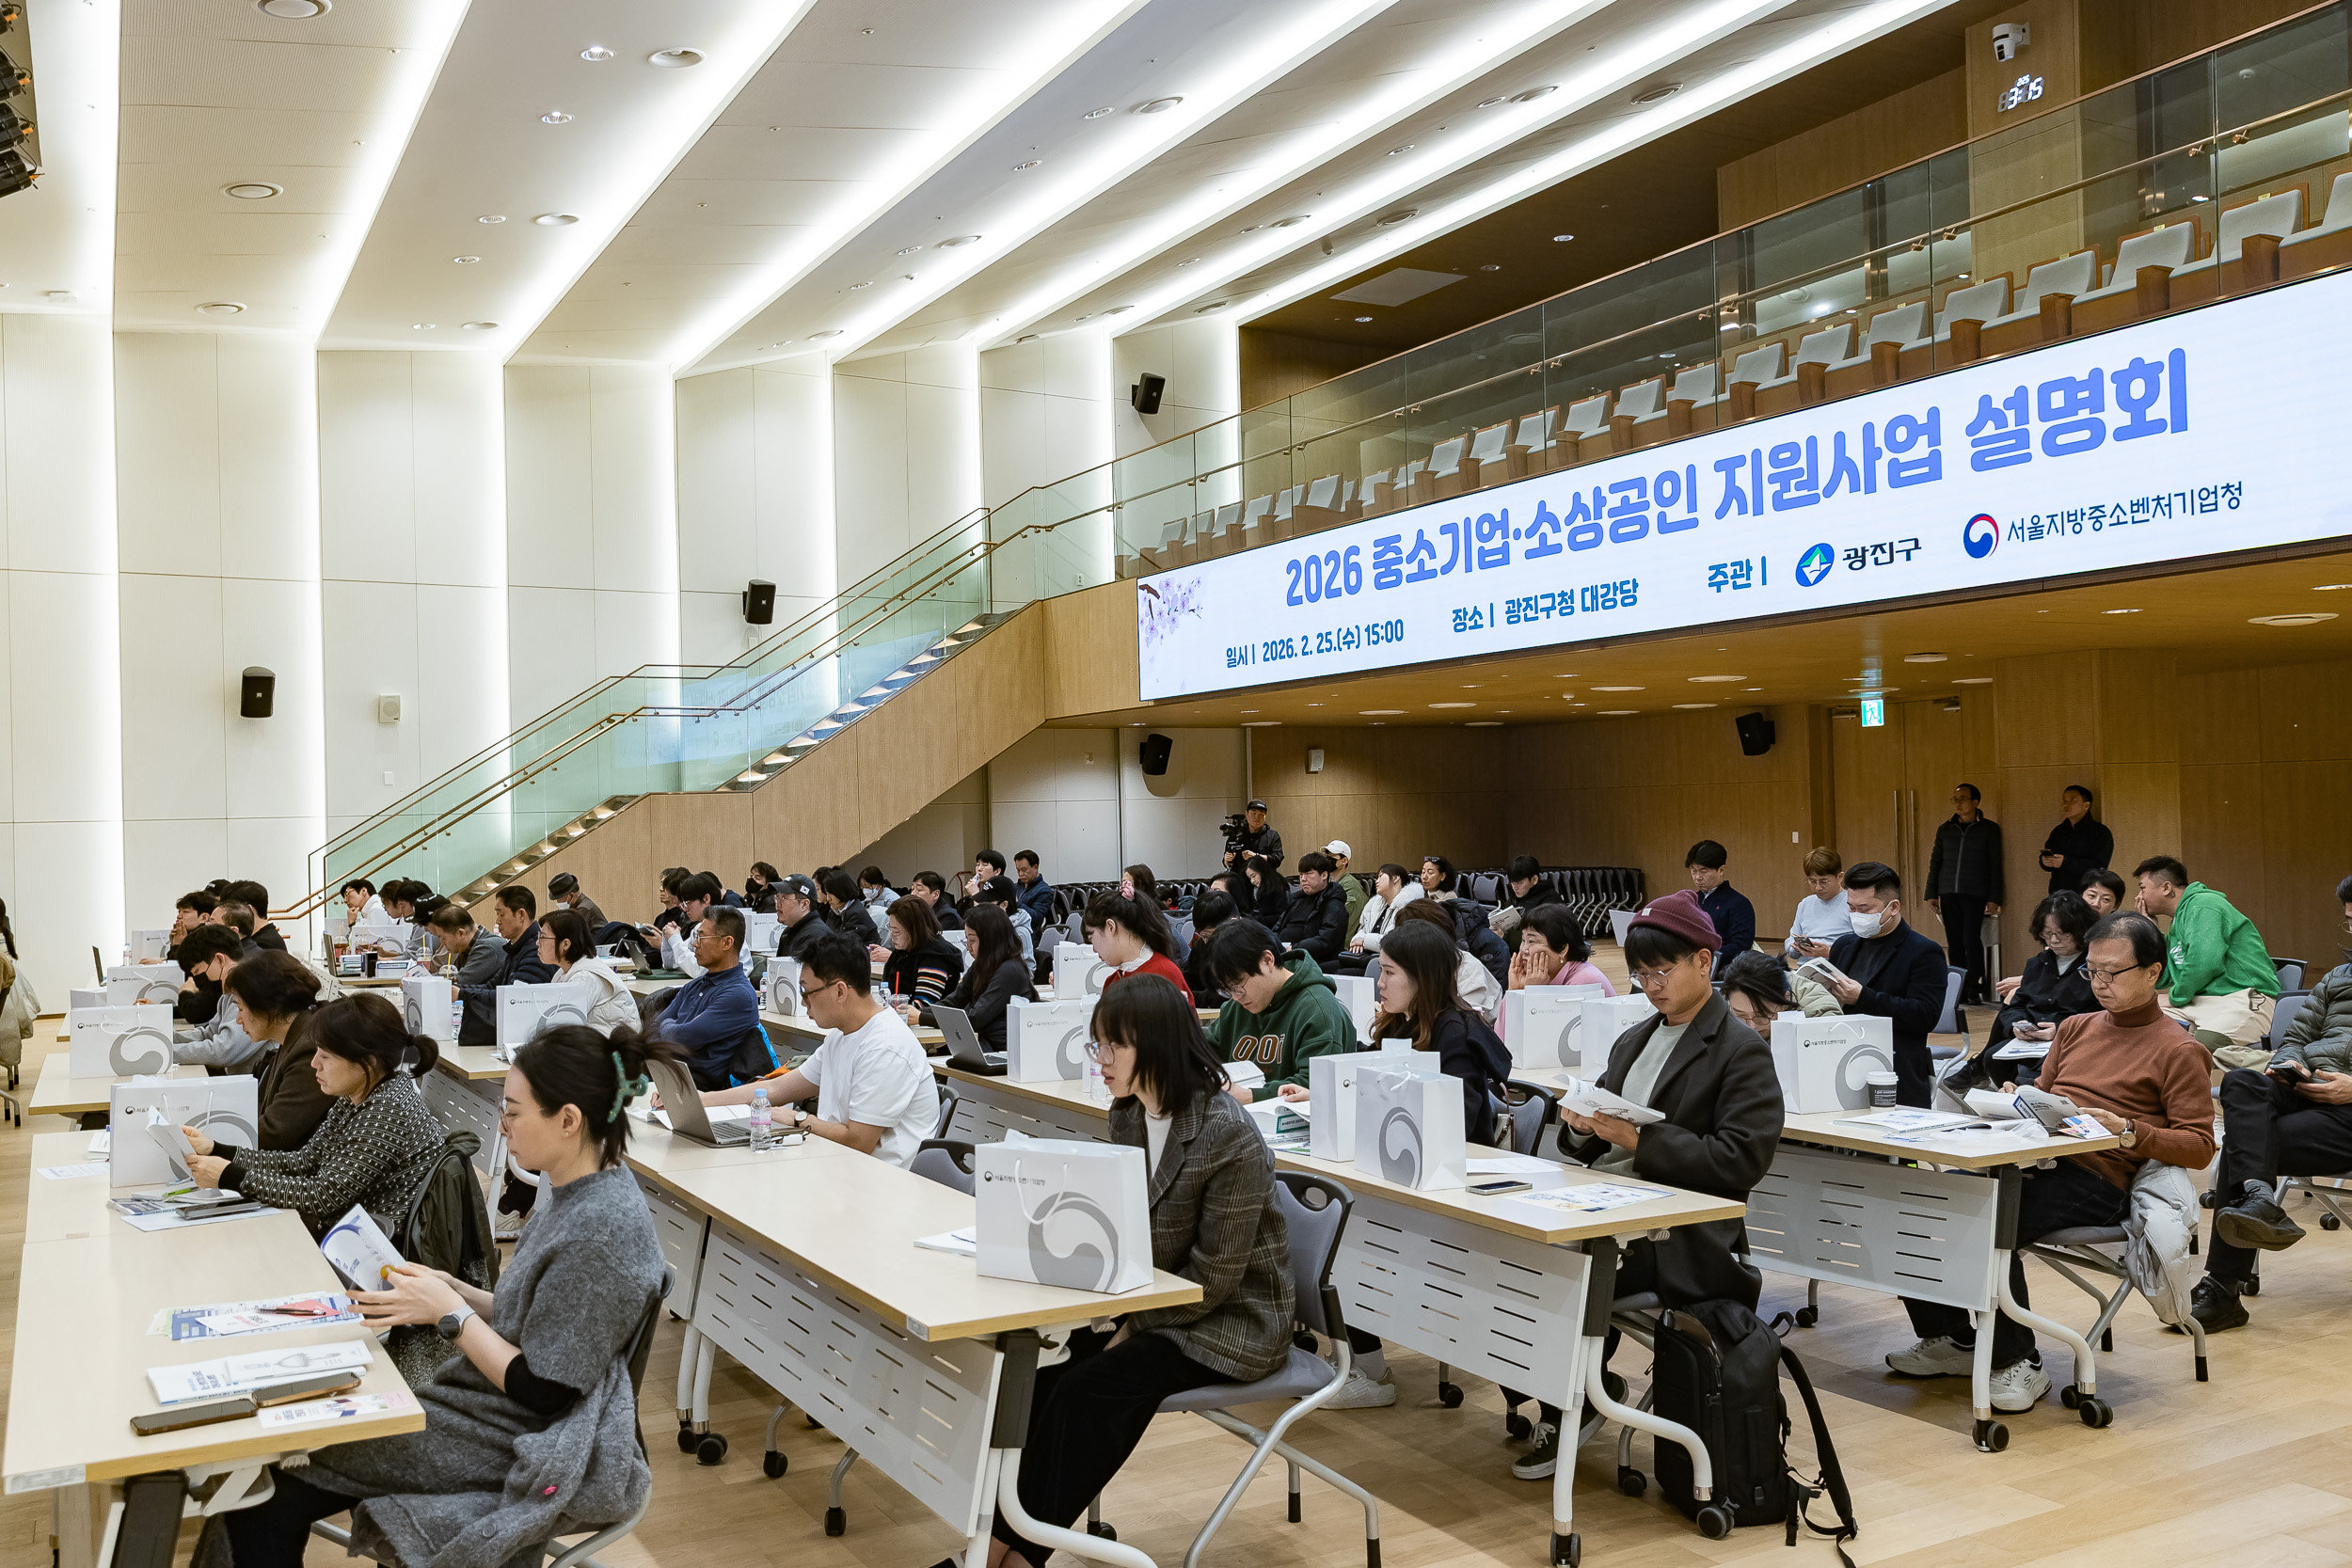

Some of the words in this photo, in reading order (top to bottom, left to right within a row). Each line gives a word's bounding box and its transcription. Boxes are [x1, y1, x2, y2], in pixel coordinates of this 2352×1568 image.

[2007, 76, 2043, 110] 3:15
[1285, 545, 1363, 608] 2026
[1372, 463, 1700, 591] 중소기업·소상공인
[1713, 405, 1943, 520] 지원사업
[1964, 347, 2188, 473] 설명회
[1708, 558, 1754, 594] 주관
[1841, 537, 1923, 572] 광진구
[2007, 481, 2243, 543] 서울지방중소벤처기업청
[1452, 605, 1485, 633] 장소
[1504, 588, 1575, 626] 광진구청
[1581, 578, 1640, 616] 대강당
[1226, 644, 1248, 669] 일시
[1262, 637, 1298, 663] 2026.
[1364, 618, 1405, 647] 15:00
